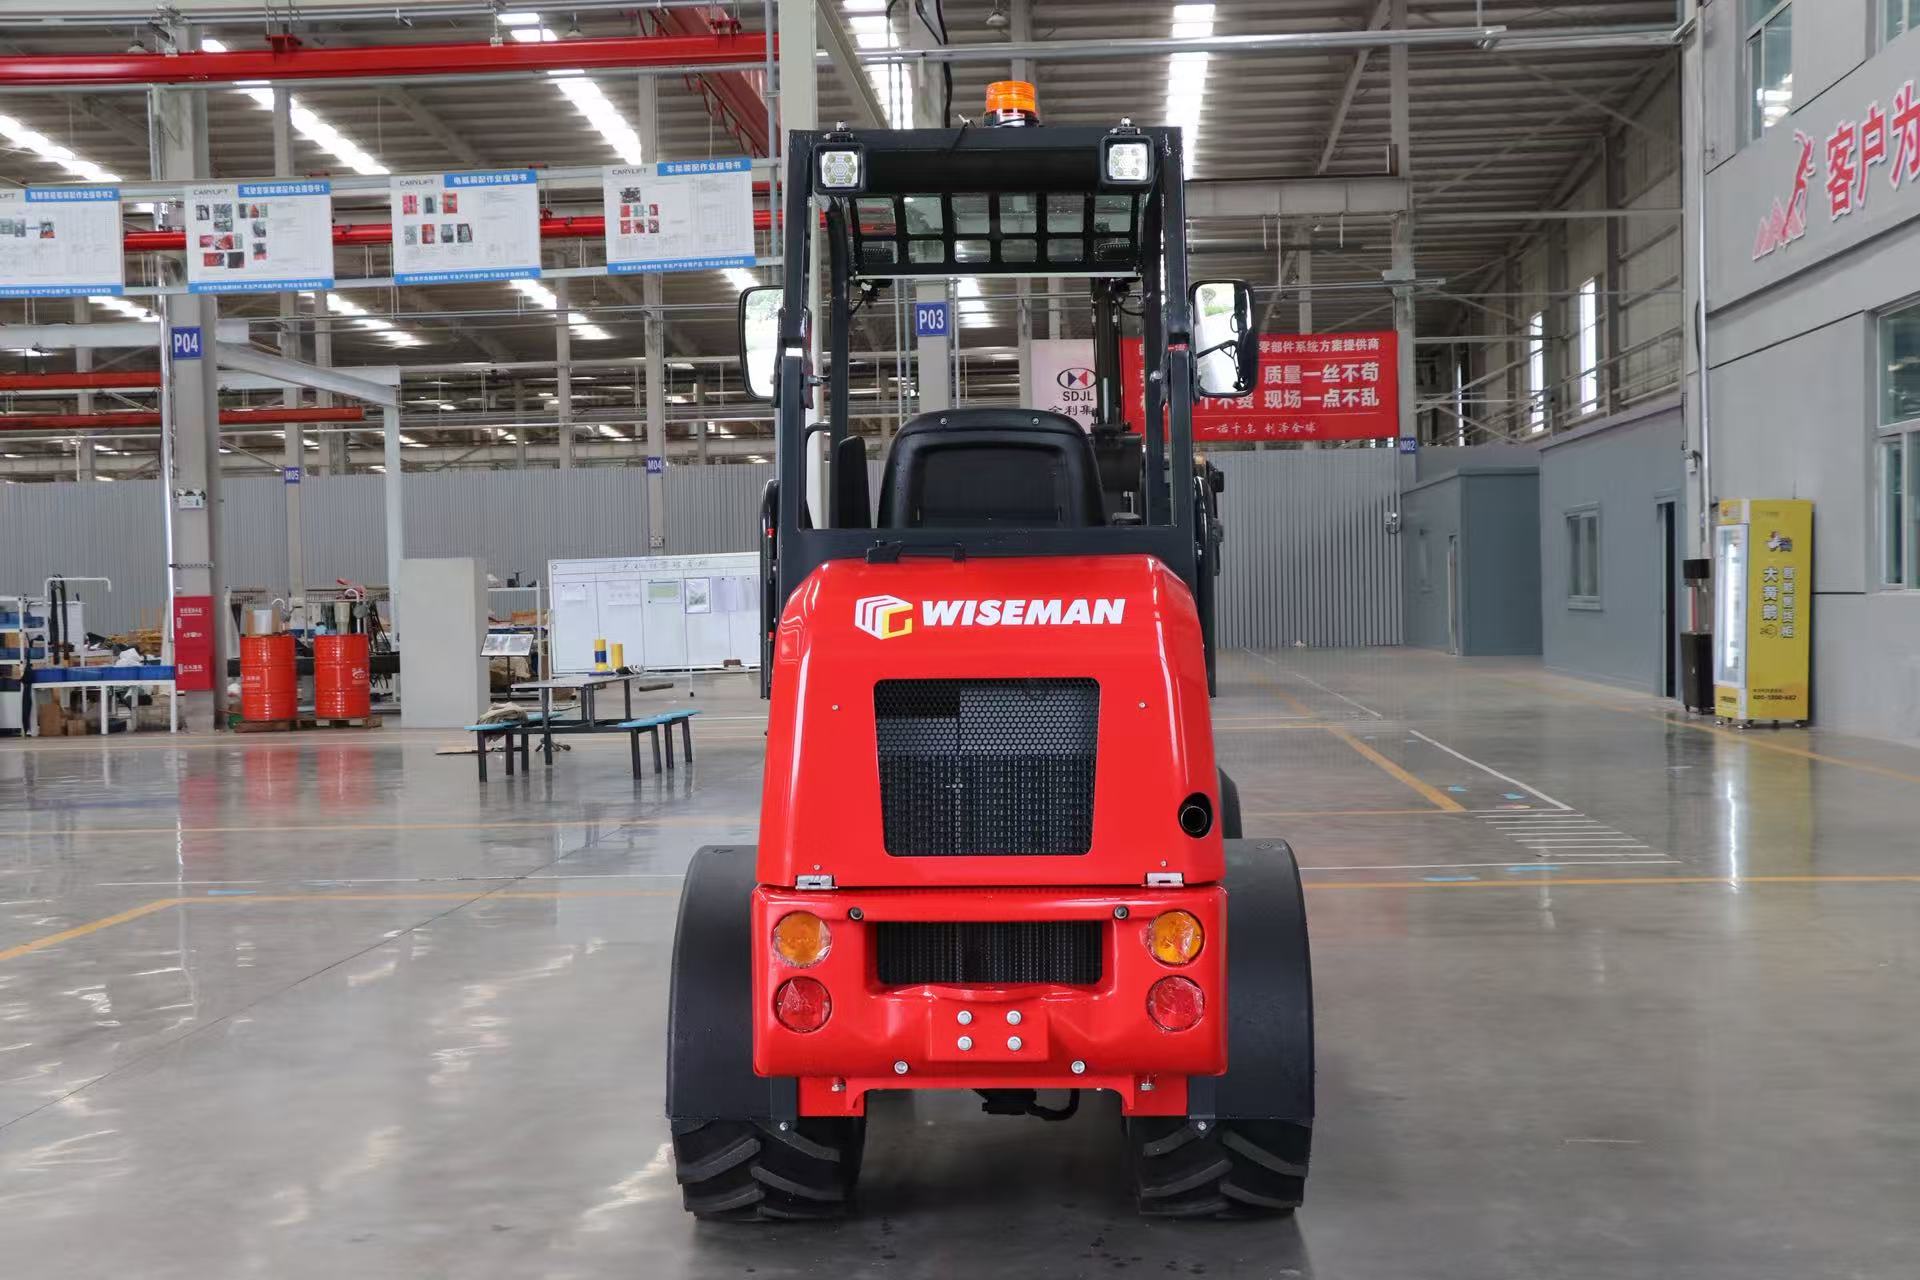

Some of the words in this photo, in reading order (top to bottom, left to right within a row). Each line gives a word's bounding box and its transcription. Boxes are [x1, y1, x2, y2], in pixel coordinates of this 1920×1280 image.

[1825, 79, 1920, 223] 客户为
[919, 309, 944, 330] P03
[174, 333, 199, 353] P04
[1264, 362, 1380, 384] 质量一丝不苟
[1063, 391, 1093, 401] SDJL
[1264, 387, 1380, 408] 现场一点不乱
[648, 460, 662, 470] M04
[922, 598, 1126, 626] WISEMAN
